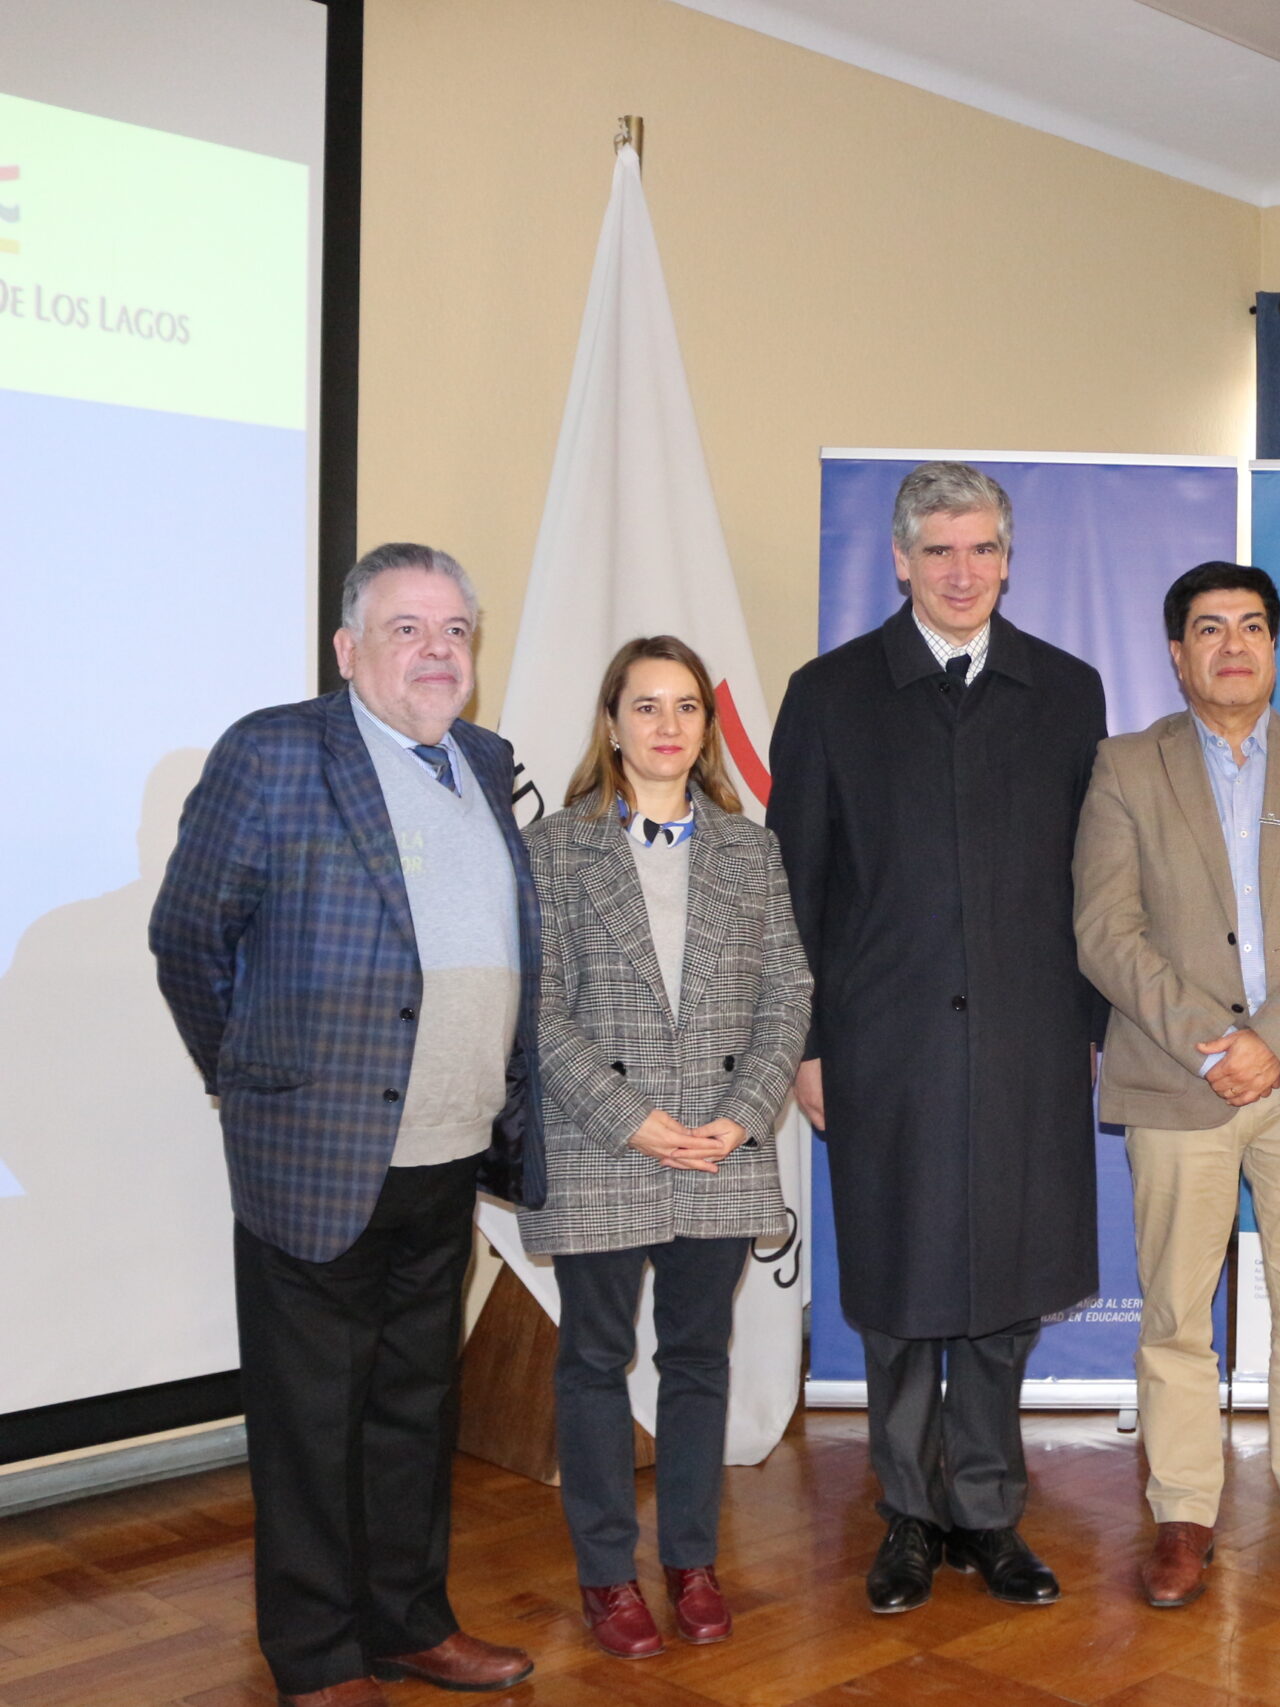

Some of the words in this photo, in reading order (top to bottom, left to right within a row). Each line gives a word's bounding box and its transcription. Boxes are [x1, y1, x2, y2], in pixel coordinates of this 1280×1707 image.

[35, 283, 89, 328] LOS
[100, 296, 190, 345] LAGOS
[1105, 1299, 1118, 1308] AL
[1069, 1312, 1082, 1322] EN
[1086, 1310, 1141, 1322] EDUCACIÓN
